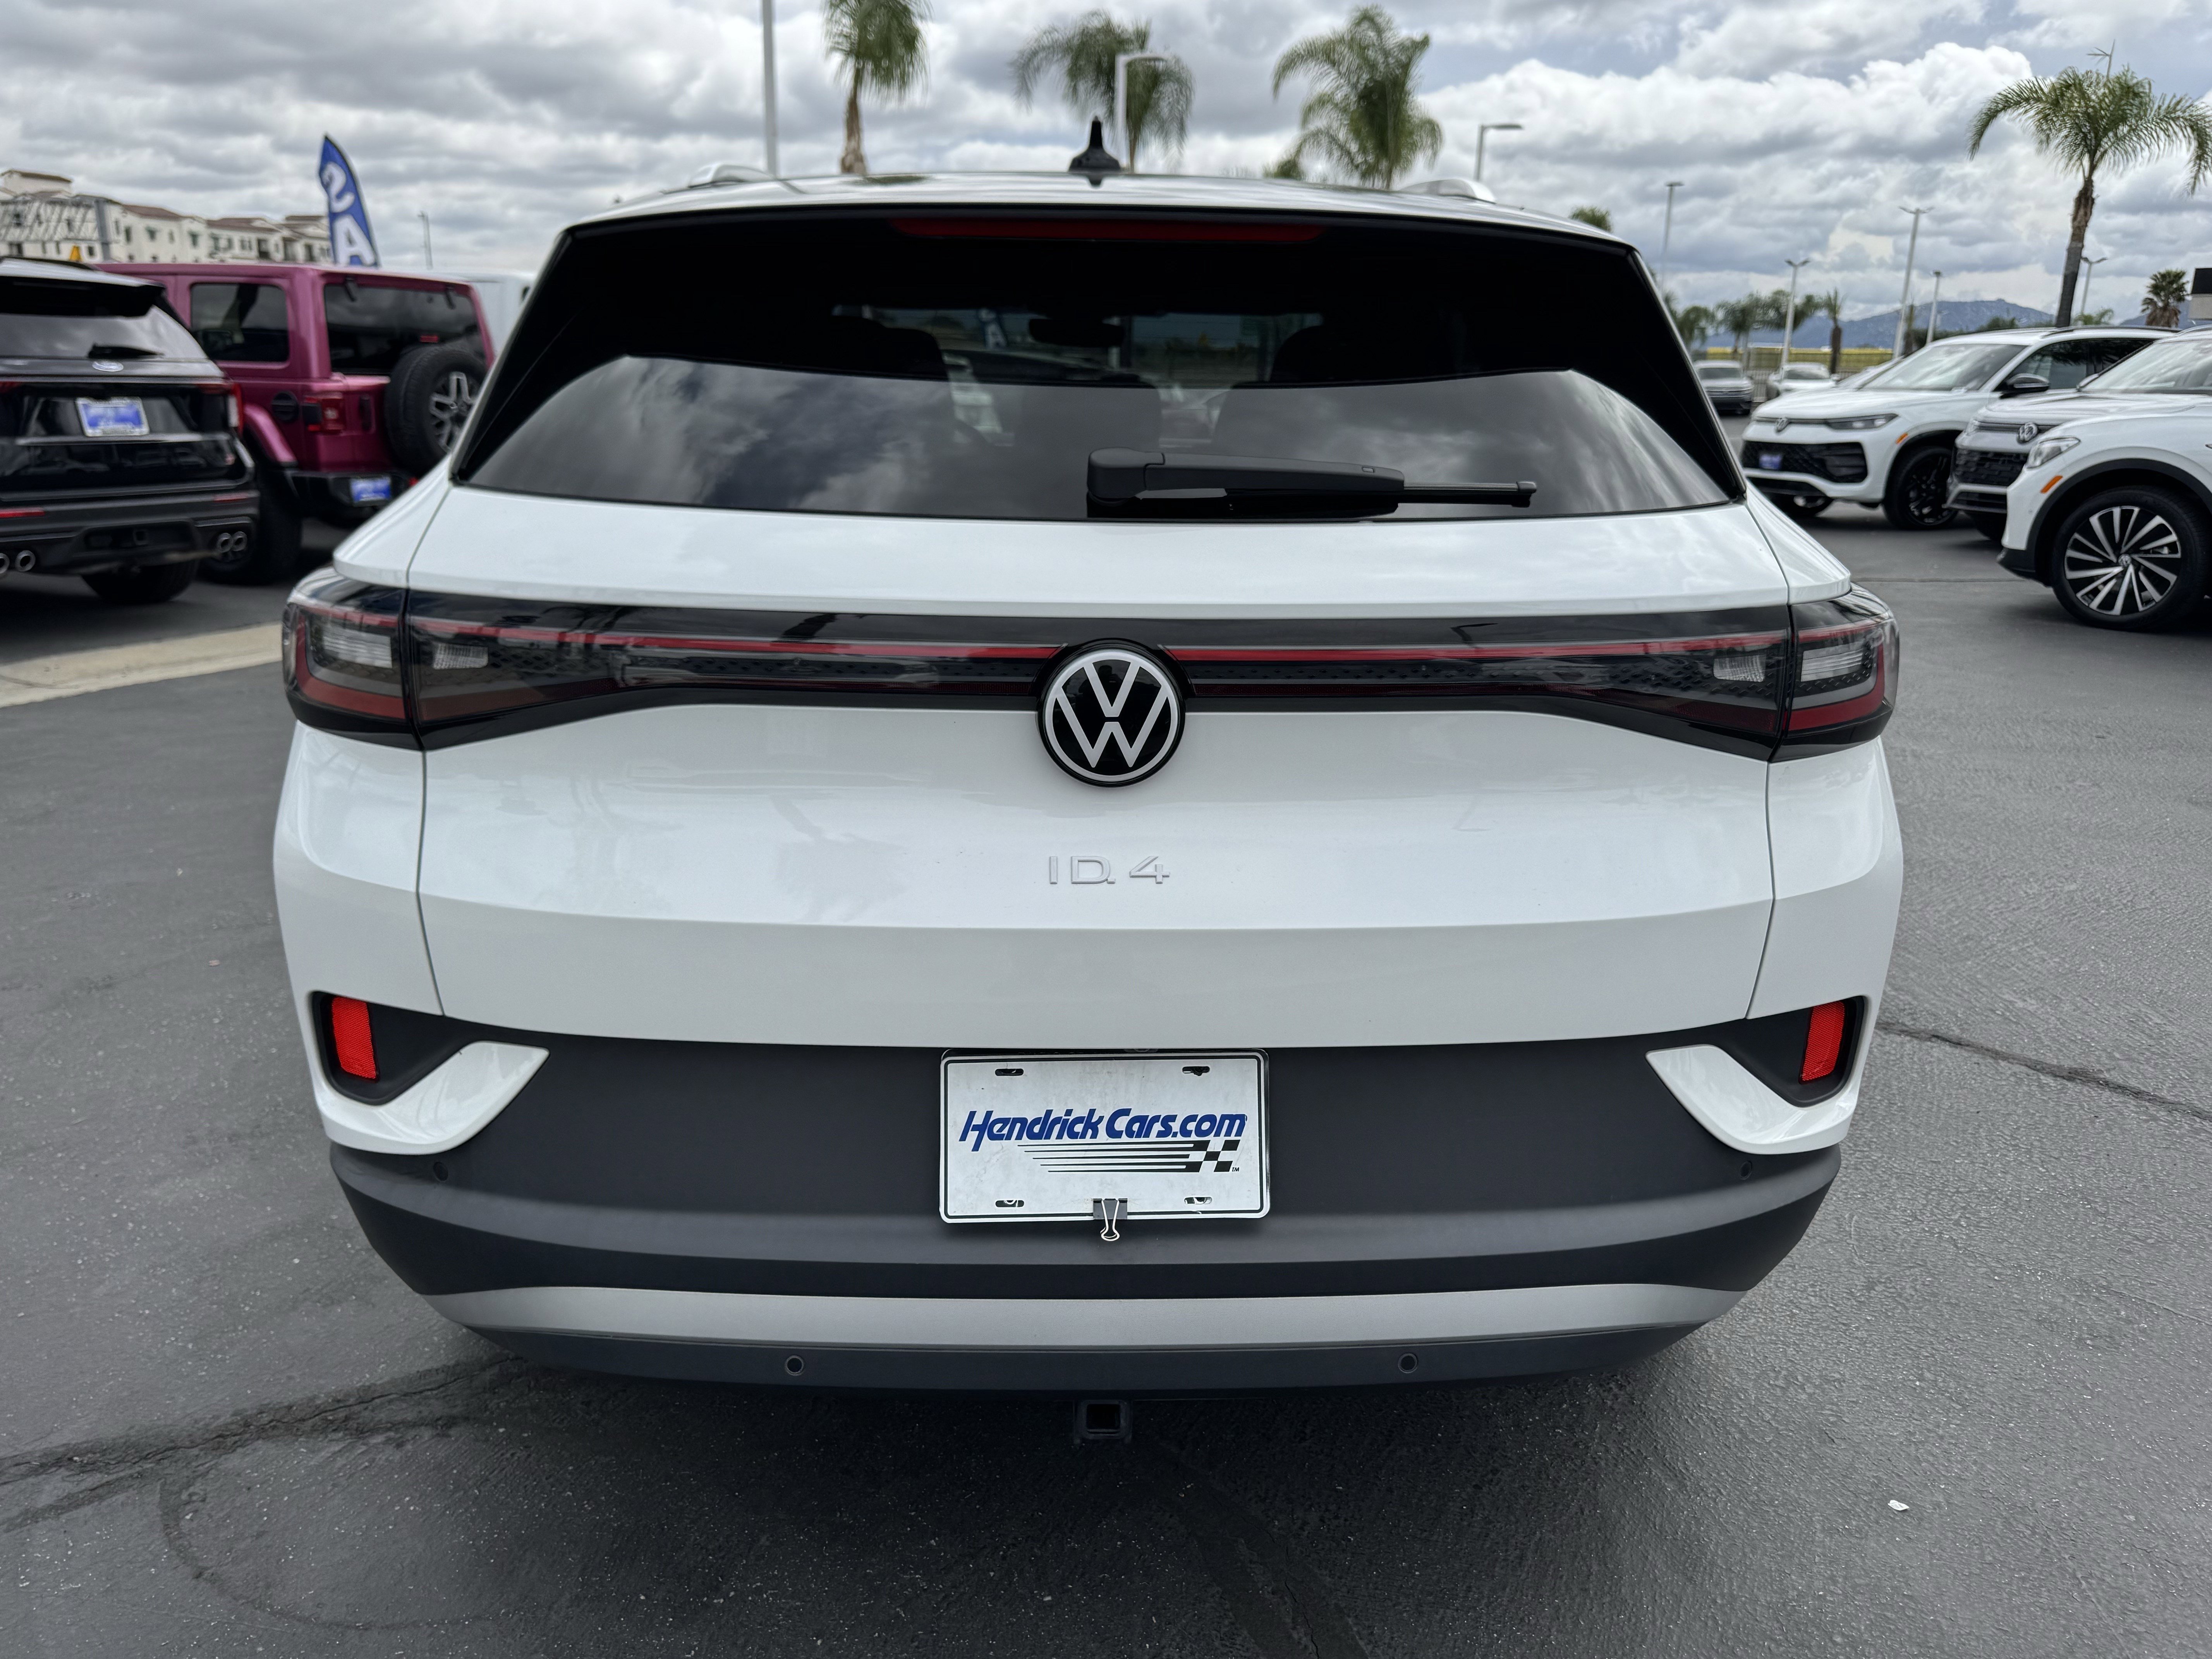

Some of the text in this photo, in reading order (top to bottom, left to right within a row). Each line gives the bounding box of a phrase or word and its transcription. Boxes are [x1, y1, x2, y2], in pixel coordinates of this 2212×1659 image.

[1052, 658, 1170, 768] VW
[958, 1108, 1248, 1152] Hendrick Cars.com
